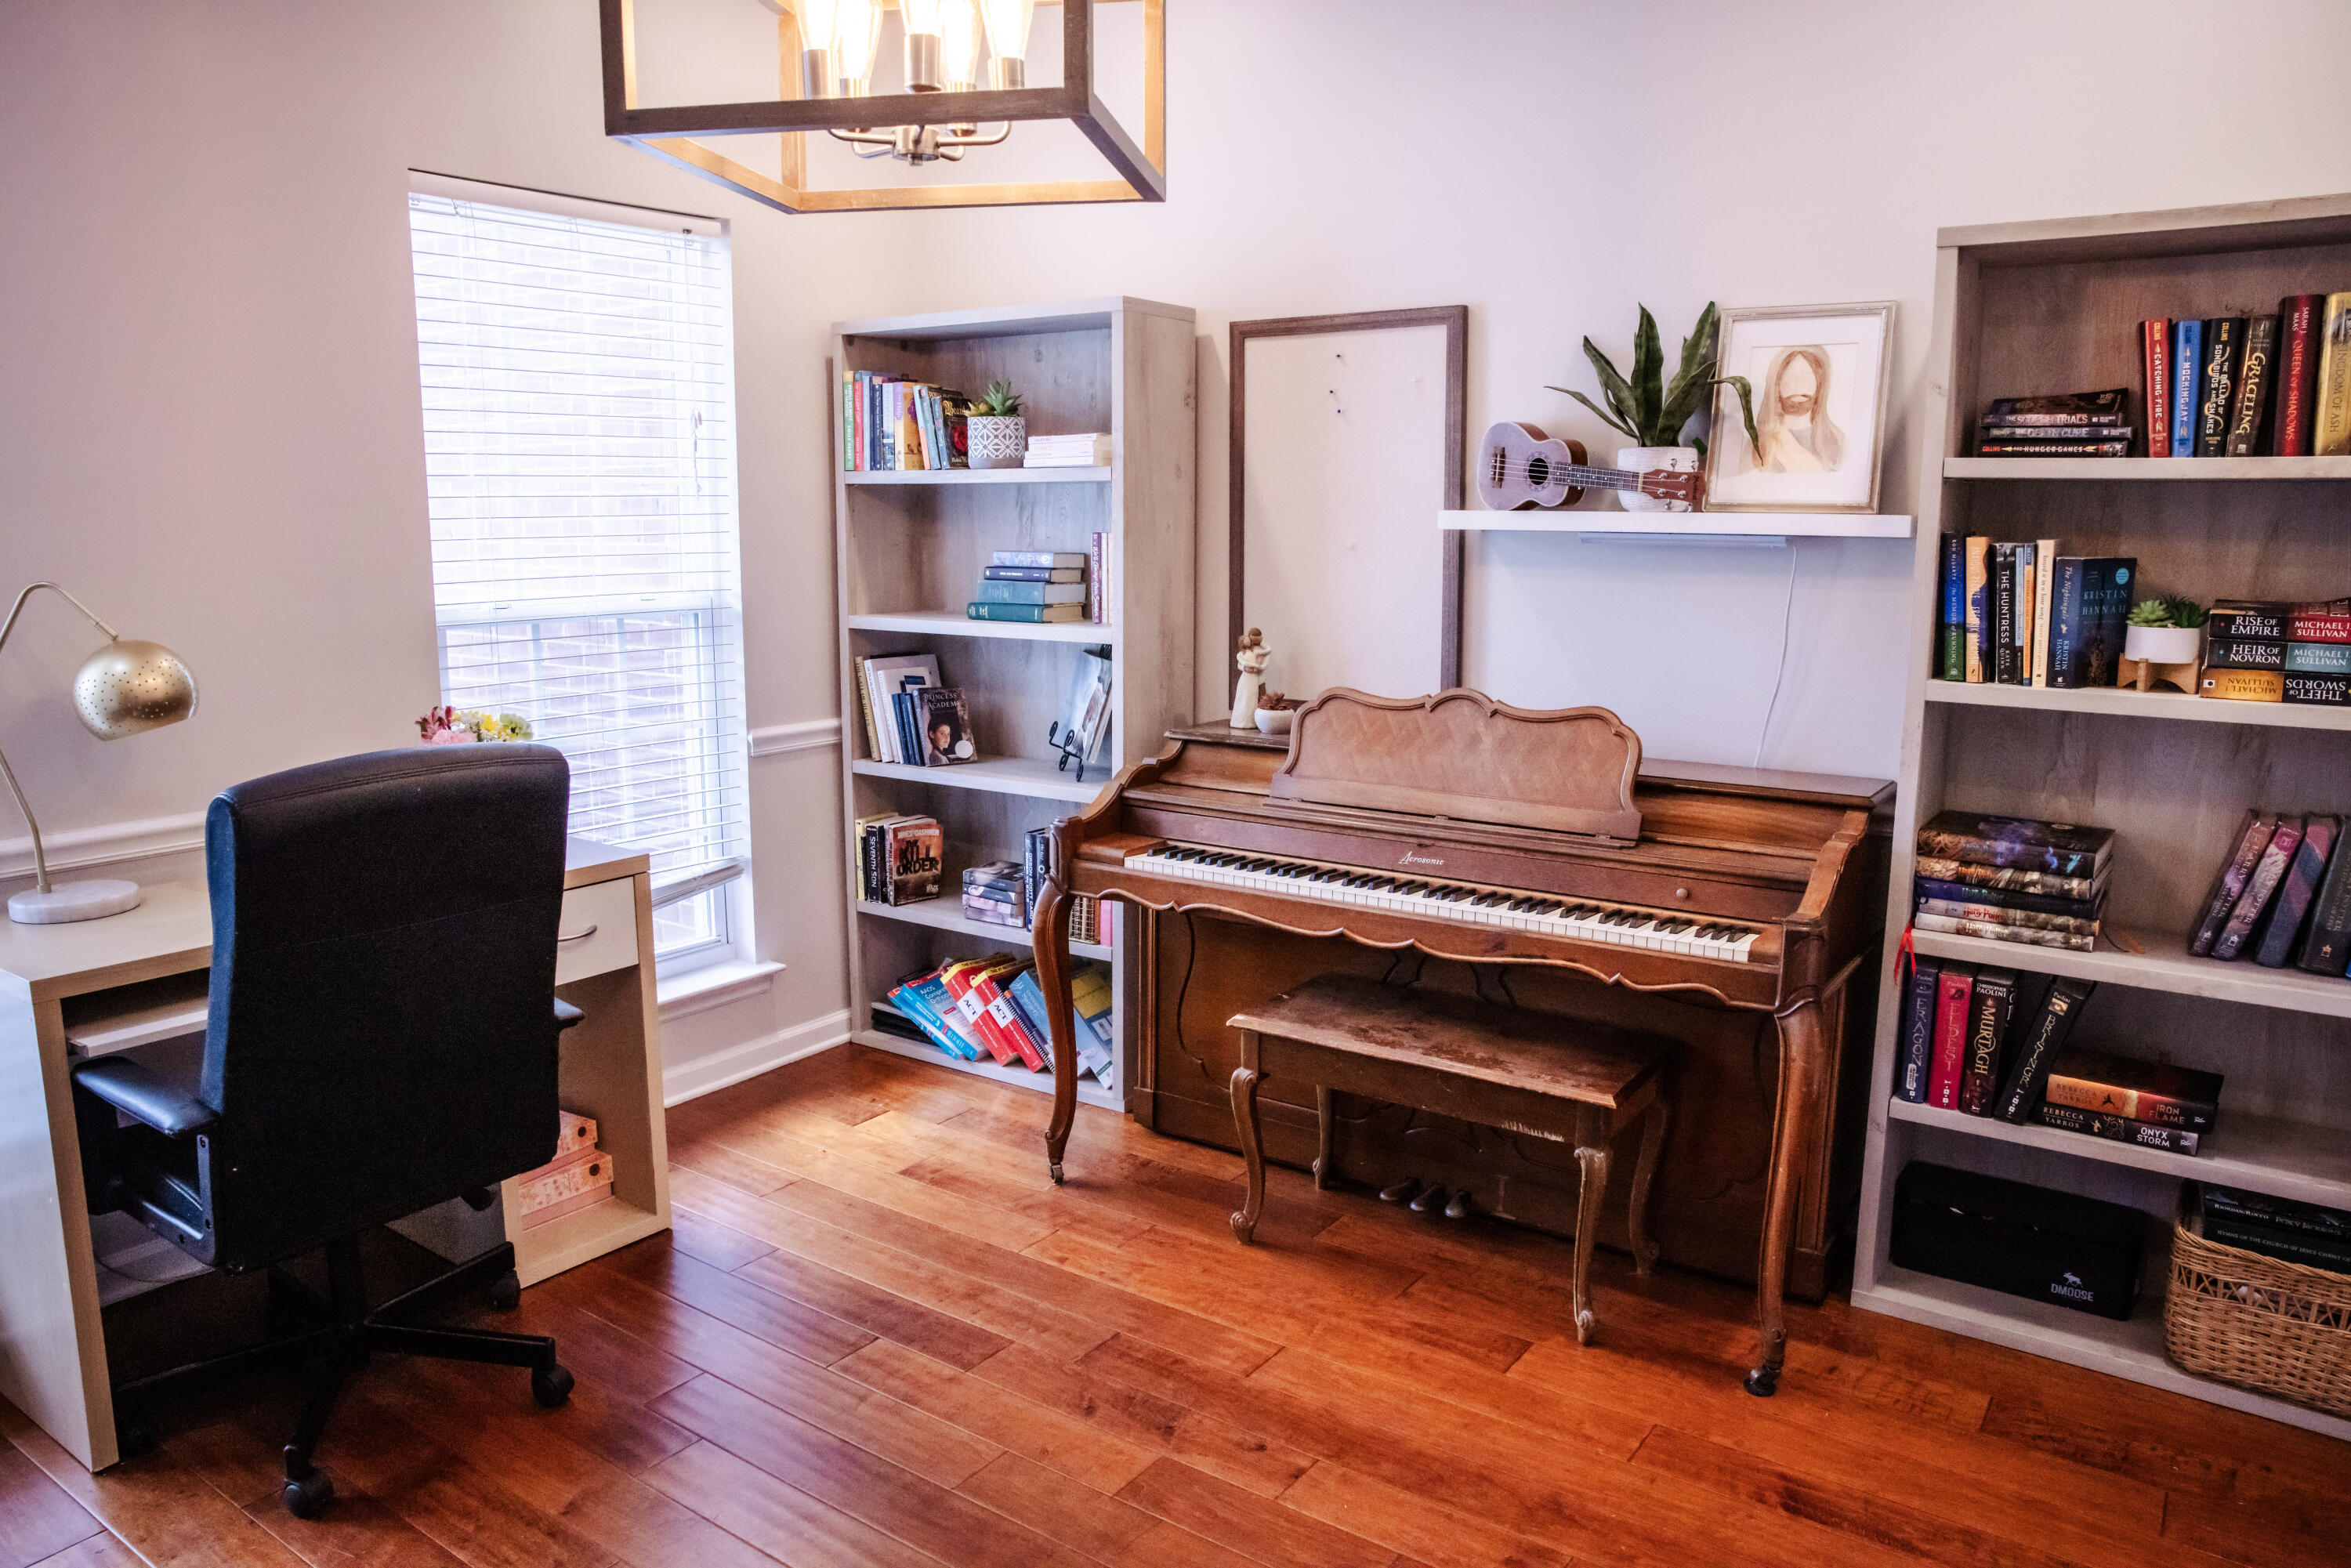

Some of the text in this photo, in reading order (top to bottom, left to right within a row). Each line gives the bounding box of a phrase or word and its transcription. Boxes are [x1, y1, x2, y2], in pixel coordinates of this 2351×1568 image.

[2220, 322, 2230, 341] COLLINS
[2291, 340, 2303, 375] QUEEN
[2211, 344, 2223, 389] SONGBIRDS
[2154, 353, 2163, 396] CATCHING
[2180, 362, 2191, 422] MOCKINGJAY
[2217, 375, 2228, 406] BALLAD
[2236, 352, 2266, 436] GRACELING
[2056, 414, 2088, 424] TRIALS
[2205, 403, 2216, 434] SNAKES
[2286, 391, 2298, 440] SHADOWS
[2329, 413, 2340, 433] ASH
[2060, 581, 2071, 620] Nightingale
[2083, 589, 2128, 599] KRISTIN
[2001, 570, 2009, 643] THE HUNTRESS
[2082, 605, 2126, 615] HANNAH
[2235, 616, 2264, 626] RISE
[2295, 621, 2343, 630] MICHAEL
[2230, 625, 2280, 636] EMPIRE
[2296, 628, 2348, 638] SULLIVAN
[2232, 644, 2266, 655] HEIR
[2294, 649, 2343, 658] MICHAEL
[2229, 654, 2281, 664] NOVRON
[2295, 656, 2347, 666] SULLIVAN
[2227, 678, 2276, 686] SULLIVAN
[2285, 679, 2347, 691] SWORDS
[2233, 685, 2277, 694] MICHAEL
[2296, 689, 2342, 701] THEFT
[922, 693, 957, 702] PRINCESS
[899, 844, 931, 864] KILL
[1398, 850, 1445, 866] Acrosonic
[896, 856, 940, 877] ORDER
[2239, 845, 2260, 881] HARRY
[1963, 906, 2005, 920] Harry Potter
[2244, 888, 2267, 924] POTTER
[919, 985, 936, 995] AAOS
[1976, 983, 2007, 991] CHRISTOPHER
[1976, 987, 2007, 998] PAOLINI
[2053, 991, 2071, 1003] Paolini
[963, 999, 978, 1016] ACT
[994, 1004, 1009, 1020] ACT
[1912, 998, 1927, 1066] ERAGON
[1944, 1002, 1961, 1072] ELDEST
[1973, 1005, 1996, 1075] MURTAGH
[2020, 1014, 2056, 1086] BRISINGR
[2056, 1083, 2097, 1096] REBECCA
[2043, 1106, 2085, 1121] REBECCA
[2156, 1104, 2180, 1115] IRON
[2045, 1117, 2081, 1128] YARROS
[2149, 1110, 2186, 1124] FLAME
[2140, 1127, 2168, 1139] ONYX
[2137, 1134, 2171, 1147] STORM
[2275, 1216, 2302, 1227] PERCY
[2217, 1229, 2239, 1239] HYMNS
[2262, 1240, 2289, 1249] CHURCH
[2299, 1246, 2317, 1255] JESUS
[2318, 1251, 2342, 1261] CHRIST
[2051, 1283, 2095, 1302] DMOOSE
